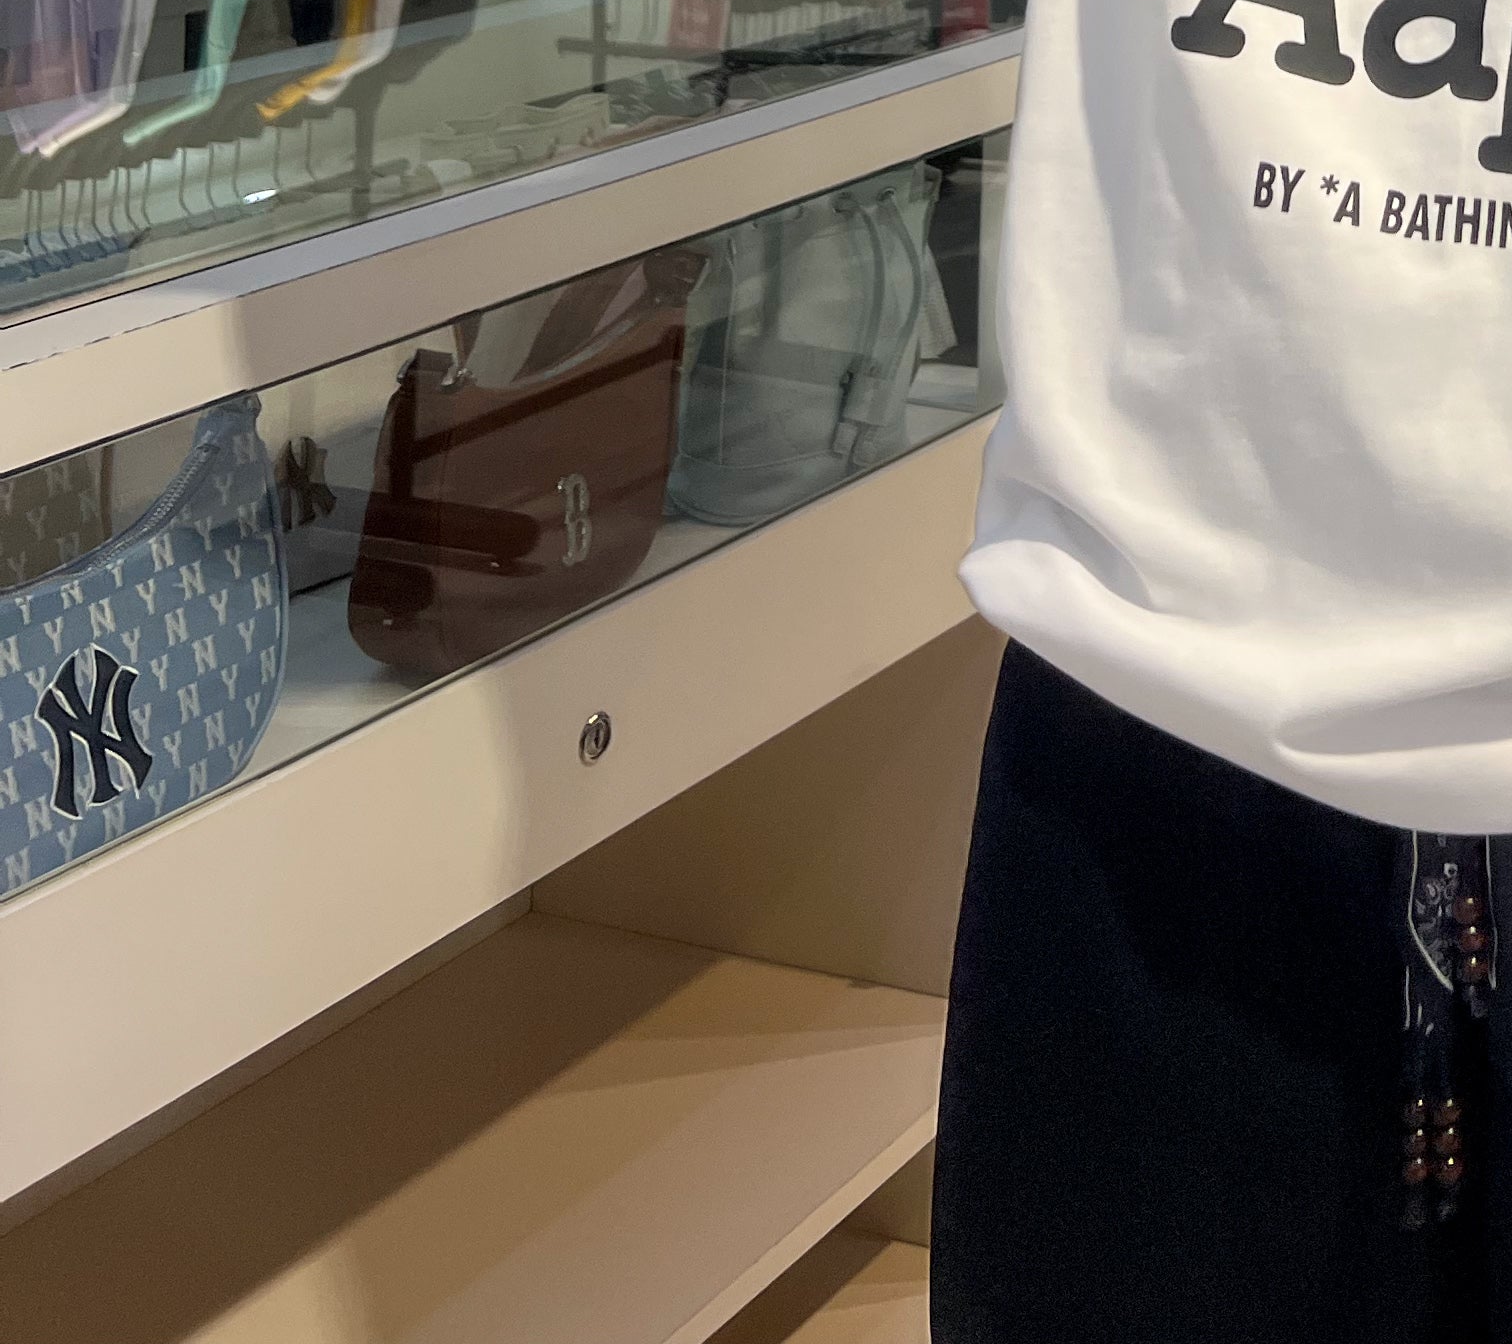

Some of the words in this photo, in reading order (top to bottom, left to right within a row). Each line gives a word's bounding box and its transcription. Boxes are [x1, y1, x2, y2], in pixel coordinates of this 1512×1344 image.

[1253, 161, 1305, 213] BY
[214, 474, 233, 505] Y
[14, 595, 33, 625] Y
[60, 579, 84, 610] N
[151, 532, 174, 572] N
[194, 516, 213, 551] Y
[42, 616, 64, 655] Y
[88, 597, 116, 640] N
[135, 578, 156, 615] Y
[177, 560, 206, 601] N
[224, 545, 241, 580] Y
[120, 626, 141, 664] Y
[164, 607, 189, 647] N
[209, 588, 229, 626] Y
[251, 572, 273, 610] N
[8, 714, 37, 759] N
[149, 654, 169, 692] Y
[192, 634, 218, 676] N
[237, 617, 256, 654] Y
[177, 682, 201, 724] N
[221, 664, 239, 701] Y
[260, 645, 276, 685] N
[34, 642, 154, 821] NY
[162, 730, 182, 768] Y
[204, 710, 226, 751] N
[245, 692, 261, 728] Y
[24, 793, 52, 840] N
[147, 780, 167, 817] Y
[189, 759, 208, 799] N
[228, 739, 244, 772] Y
[57, 823, 78, 862] Y
[102, 800, 125, 842] N
[5, 846, 31, 890] N
